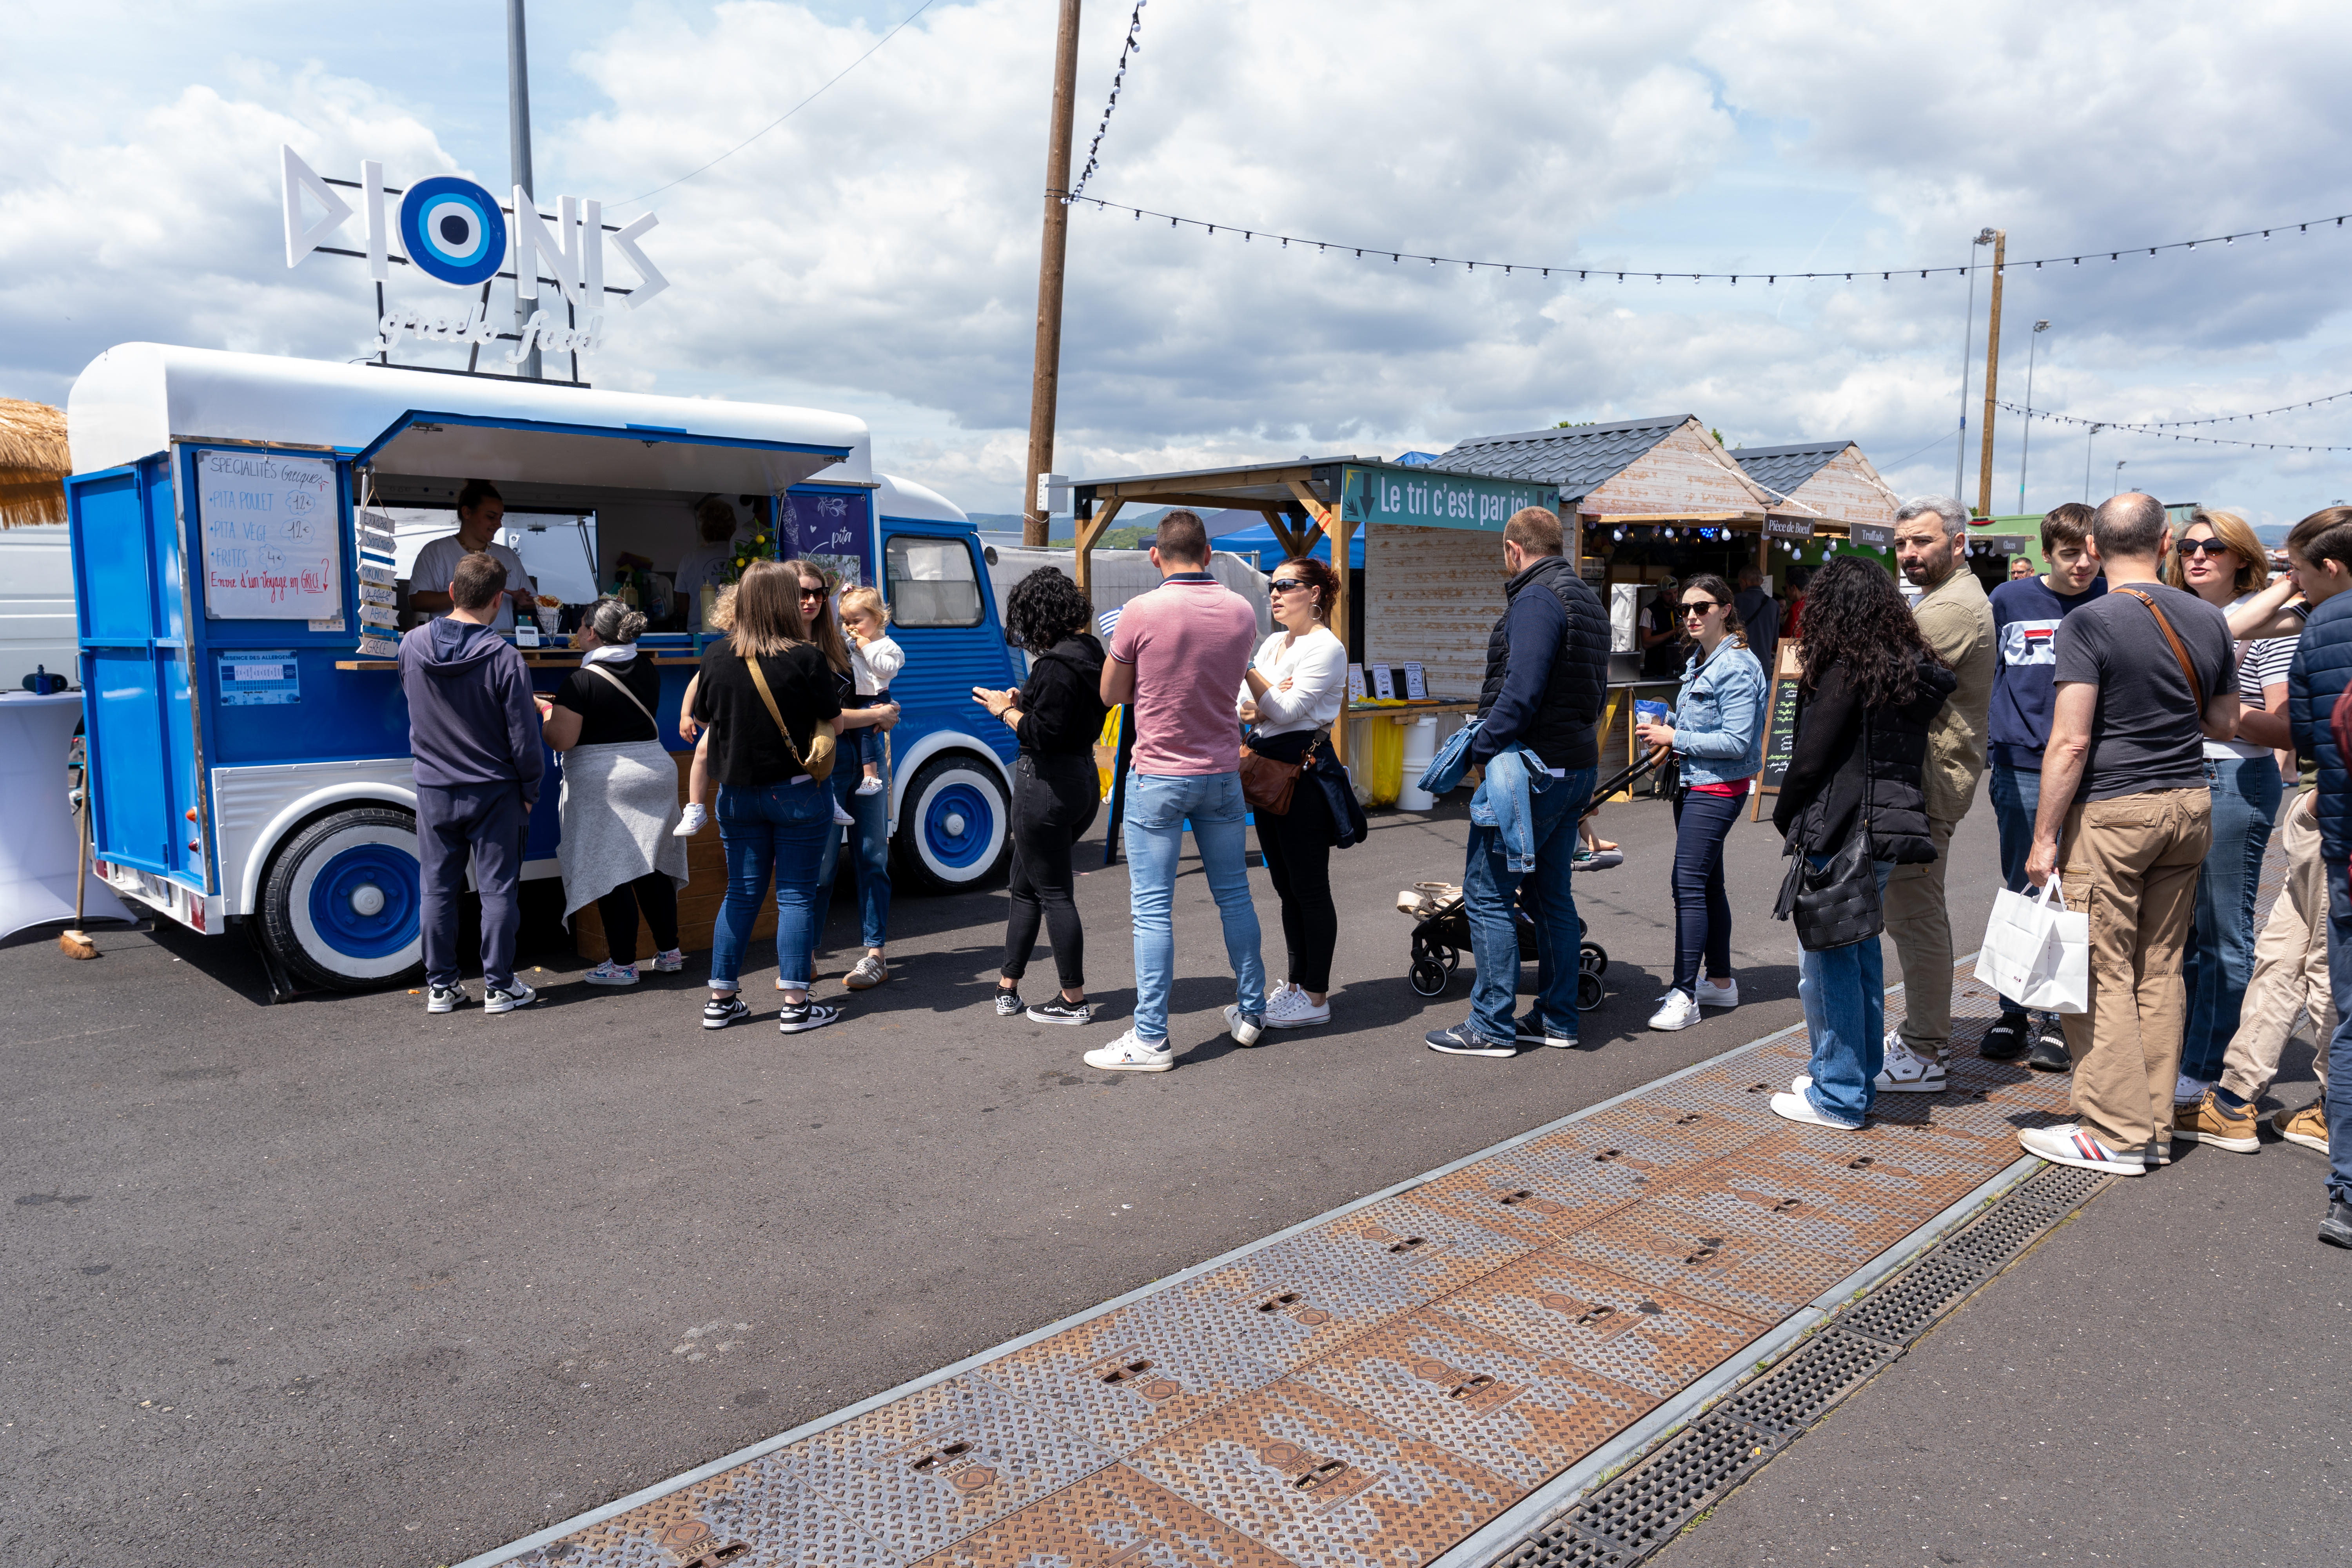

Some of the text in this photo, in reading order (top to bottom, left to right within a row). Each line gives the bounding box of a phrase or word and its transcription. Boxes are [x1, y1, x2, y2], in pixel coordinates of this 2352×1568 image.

[373, 302, 606, 365] greek food
[281, 465, 323, 490] Grecques
[213, 490, 236, 510] PITA
[240, 491, 274, 512] POULET
[1381, 477, 1400, 513] Le
[1407, 481, 1427, 515] tri
[1433, 483, 1474, 519] c'est
[1480, 494, 1506, 526] par
[214, 518, 236, 539] PITA
[1768, 519, 1785, 532] Pièce
[1787, 521, 1795, 533] de
[1862, 529, 1884, 542] Truffade
[831, 526, 852, 549] pita
[2003, 540, 2016, 550] Glaces
[216, 547, 247, 568] FRITES
[211, 571, 237, 588] Envie
[2040, 1036, 2064, 1048] PUMA
